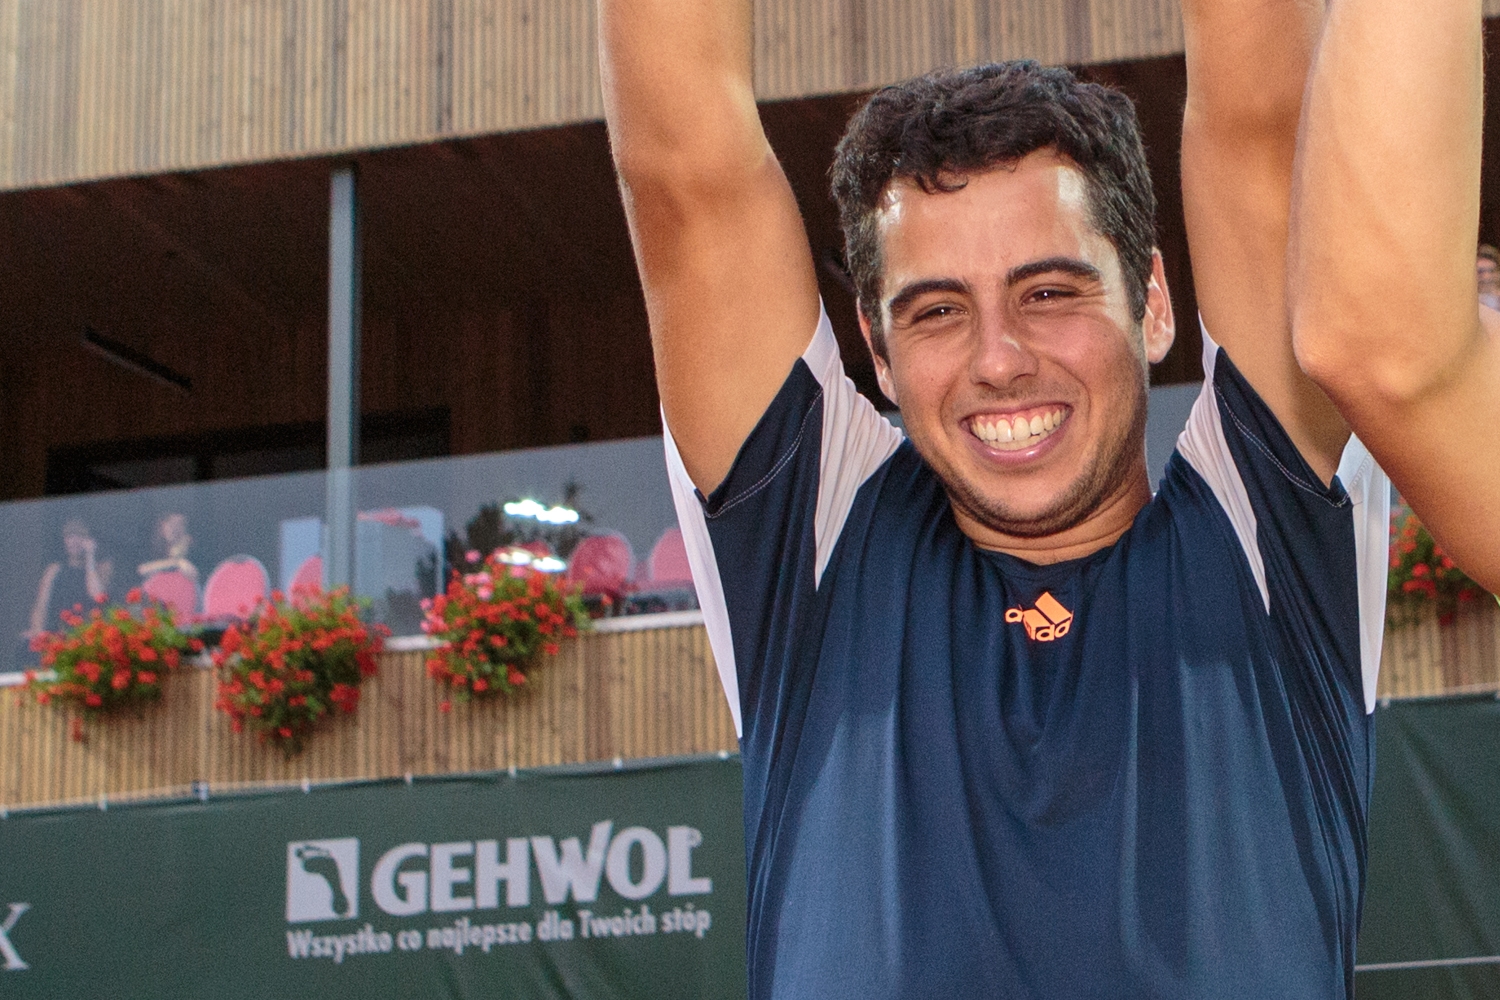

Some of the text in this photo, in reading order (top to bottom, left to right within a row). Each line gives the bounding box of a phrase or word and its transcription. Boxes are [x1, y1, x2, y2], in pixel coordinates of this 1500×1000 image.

[370, 820, 713, 917] GEHWOL
[286, 902, 712, 964] Wszystko co najlepsze dla Twoich stóp
